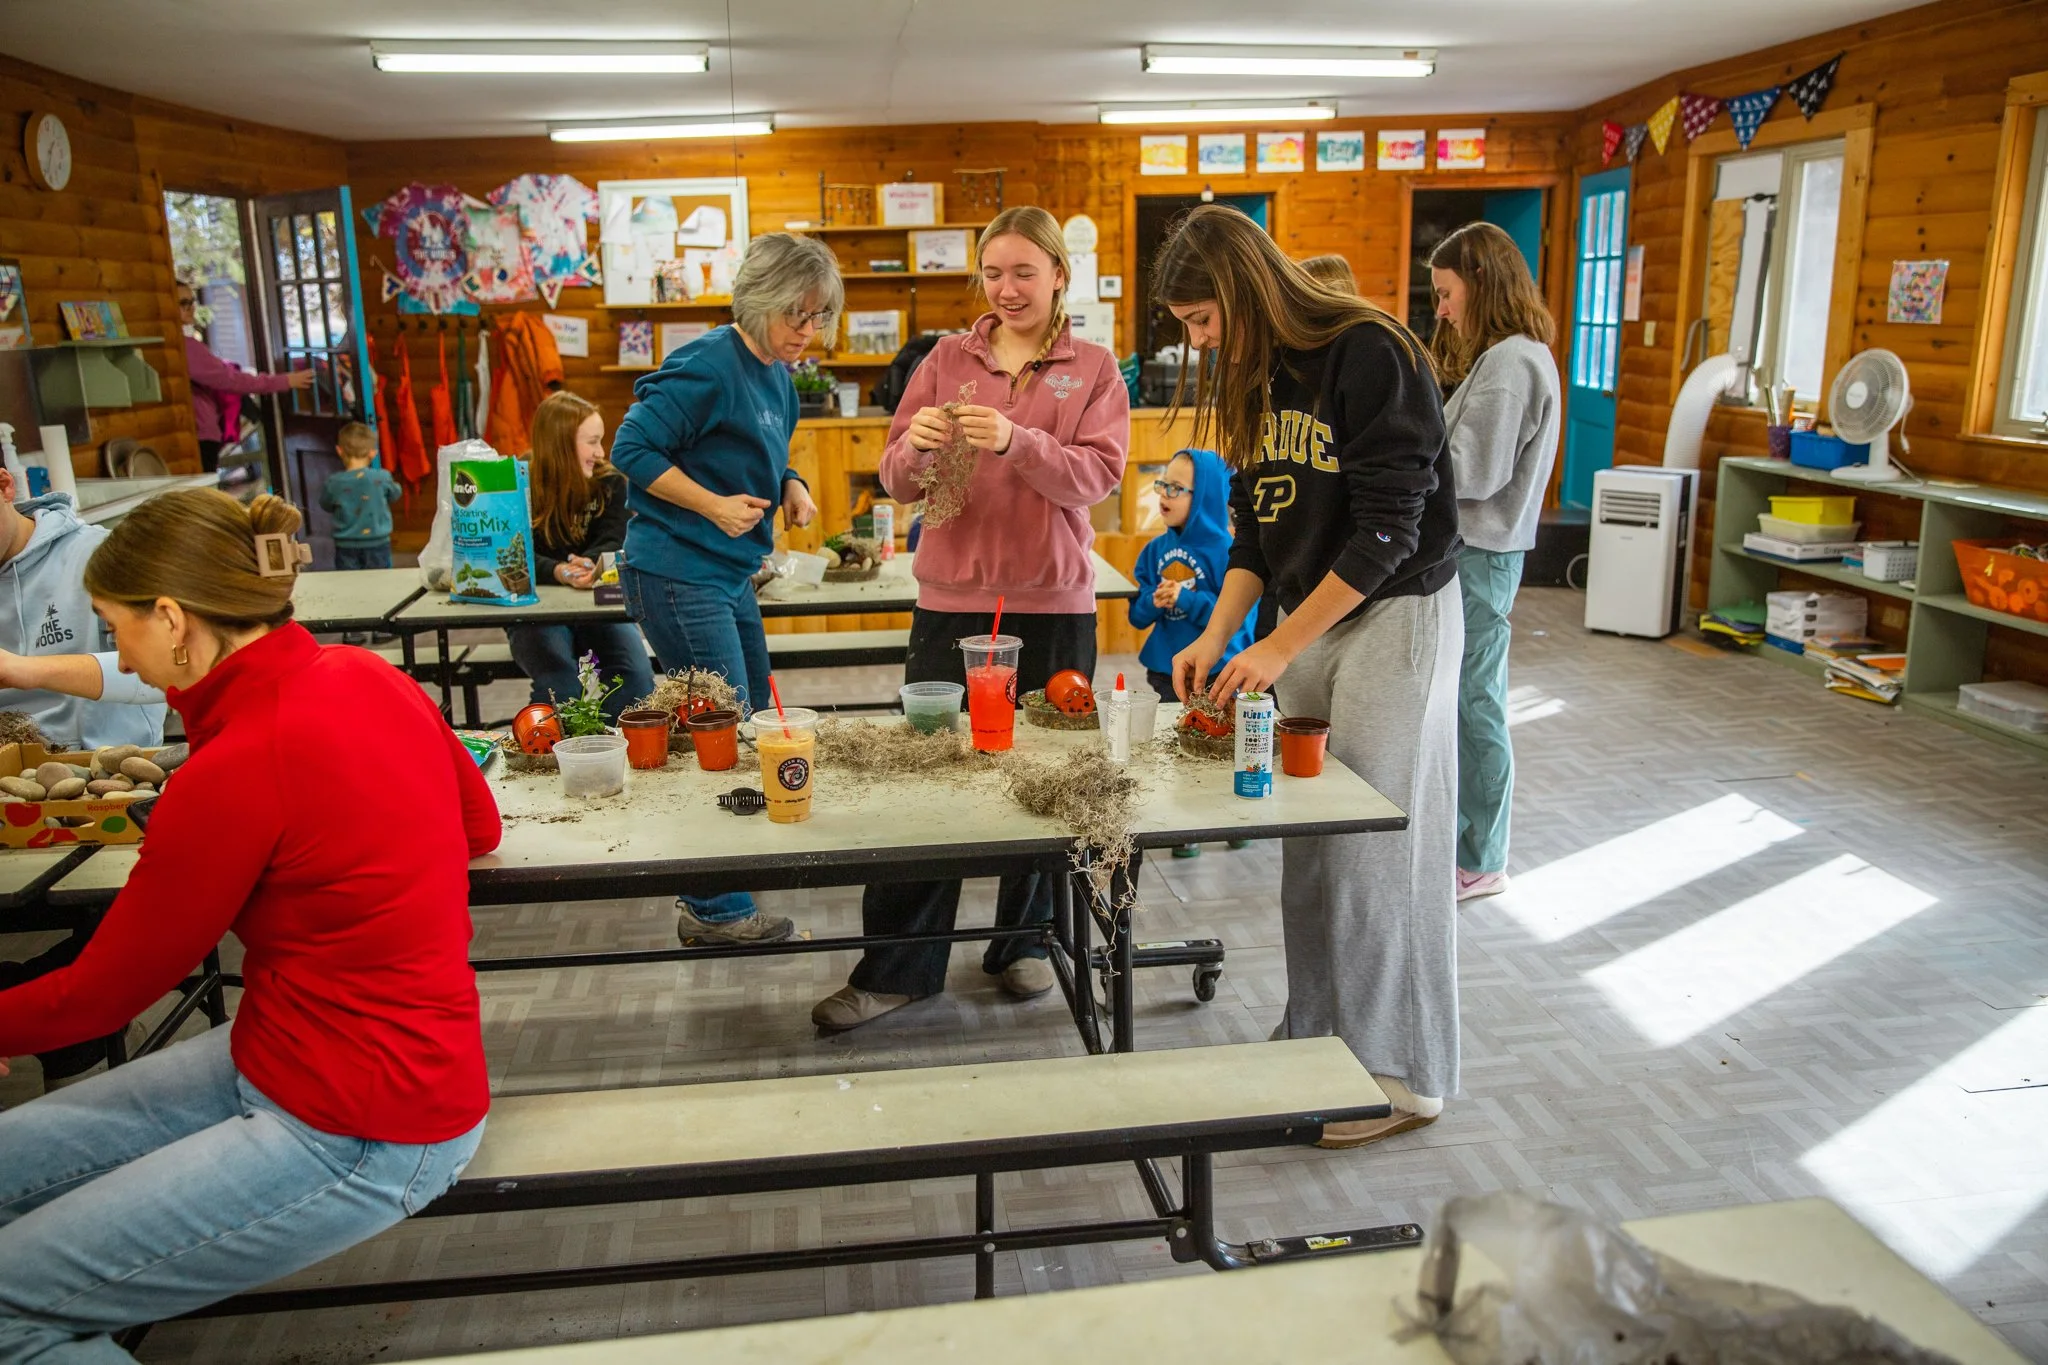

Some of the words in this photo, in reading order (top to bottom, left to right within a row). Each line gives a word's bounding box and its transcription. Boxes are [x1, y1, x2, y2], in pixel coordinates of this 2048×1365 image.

[1242, 409, 1341, 473] RDUE
[460, 509, 488, 519] Starting
[480, 516, 511, 533] Mix
[41, 618, 62, 635] THE
[35, 628, 74, 649] WOODS
